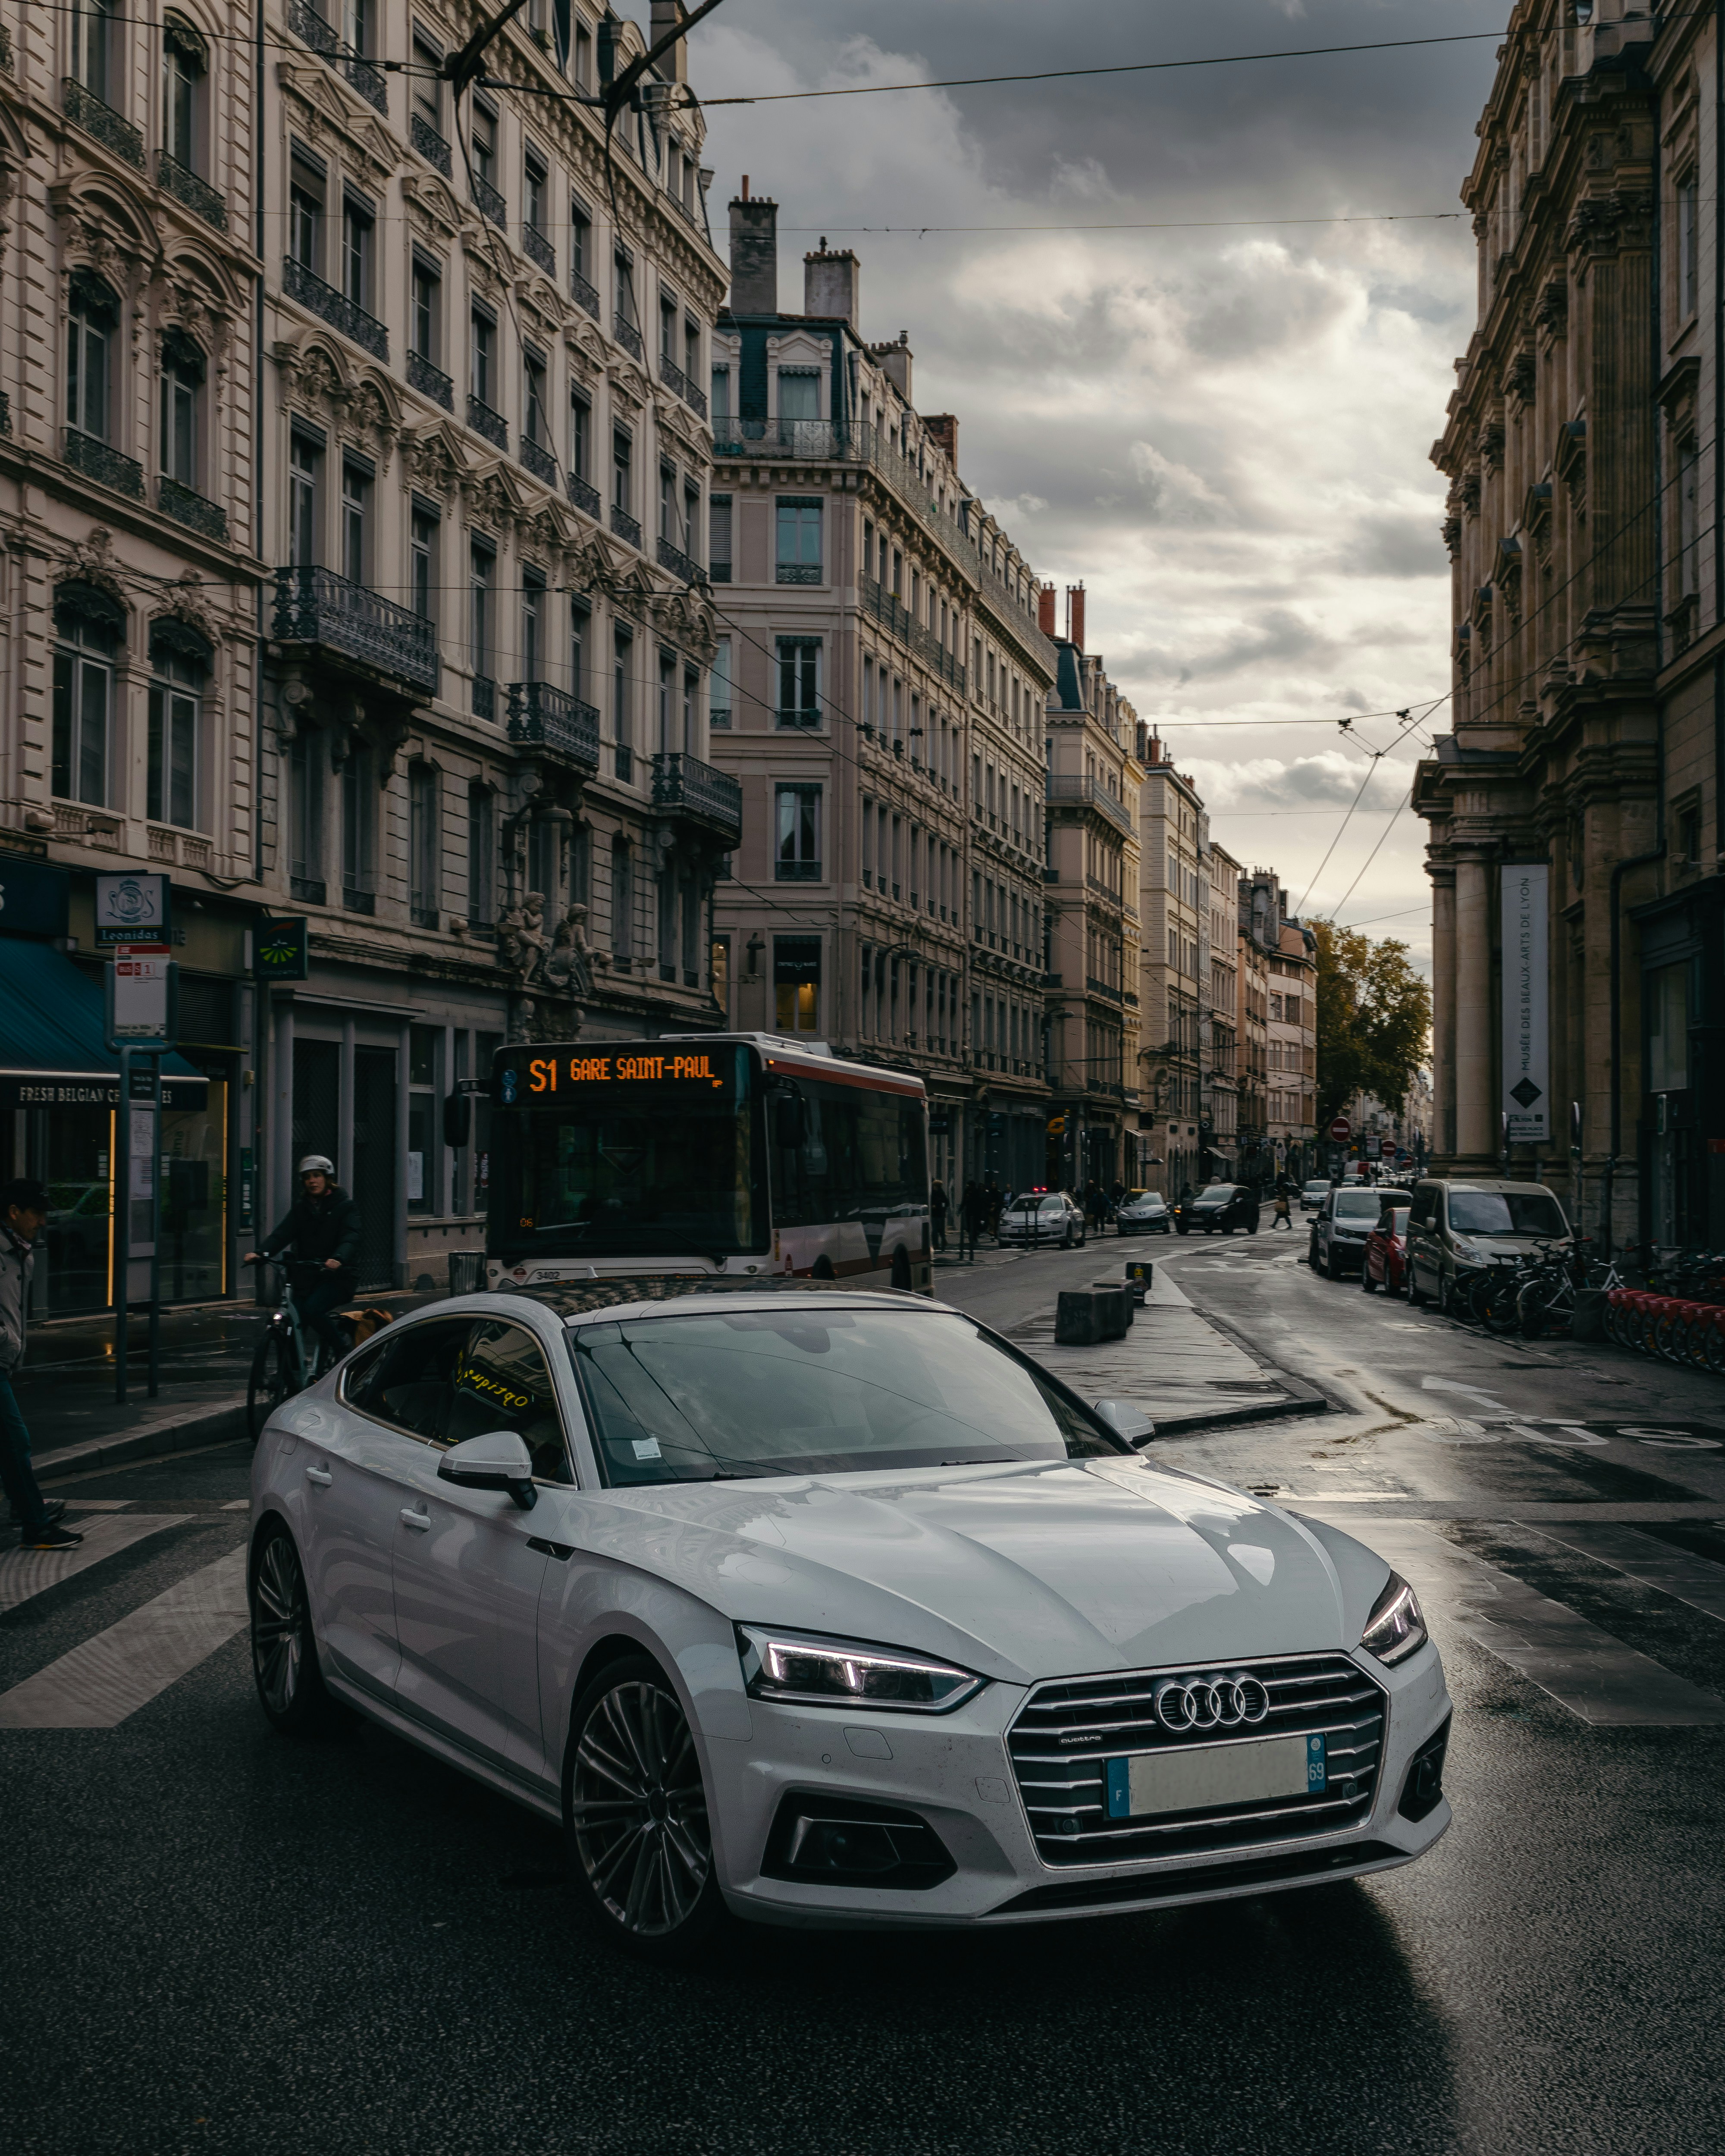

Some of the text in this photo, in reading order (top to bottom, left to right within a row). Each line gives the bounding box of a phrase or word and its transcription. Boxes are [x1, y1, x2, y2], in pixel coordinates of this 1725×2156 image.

[101, 929, 159, 940] Leonidas
[1519, 878, 1530, 1071] MUSÉE DES BEAUX-ARTS DE LYON
[530, 1056, 715, 1091] S1 GARE SAINT-PAUL
[19, 1087, 55, 1101] FRESH
[58, 1087, 104, 1102] BELGIAN
[520, 1218, 533, 1227] 06
[537, 1271, 560, 1280] 3402
[1309, 1762, 1324, 1780] 69
[1116, 1789, 1122, 1801] F
